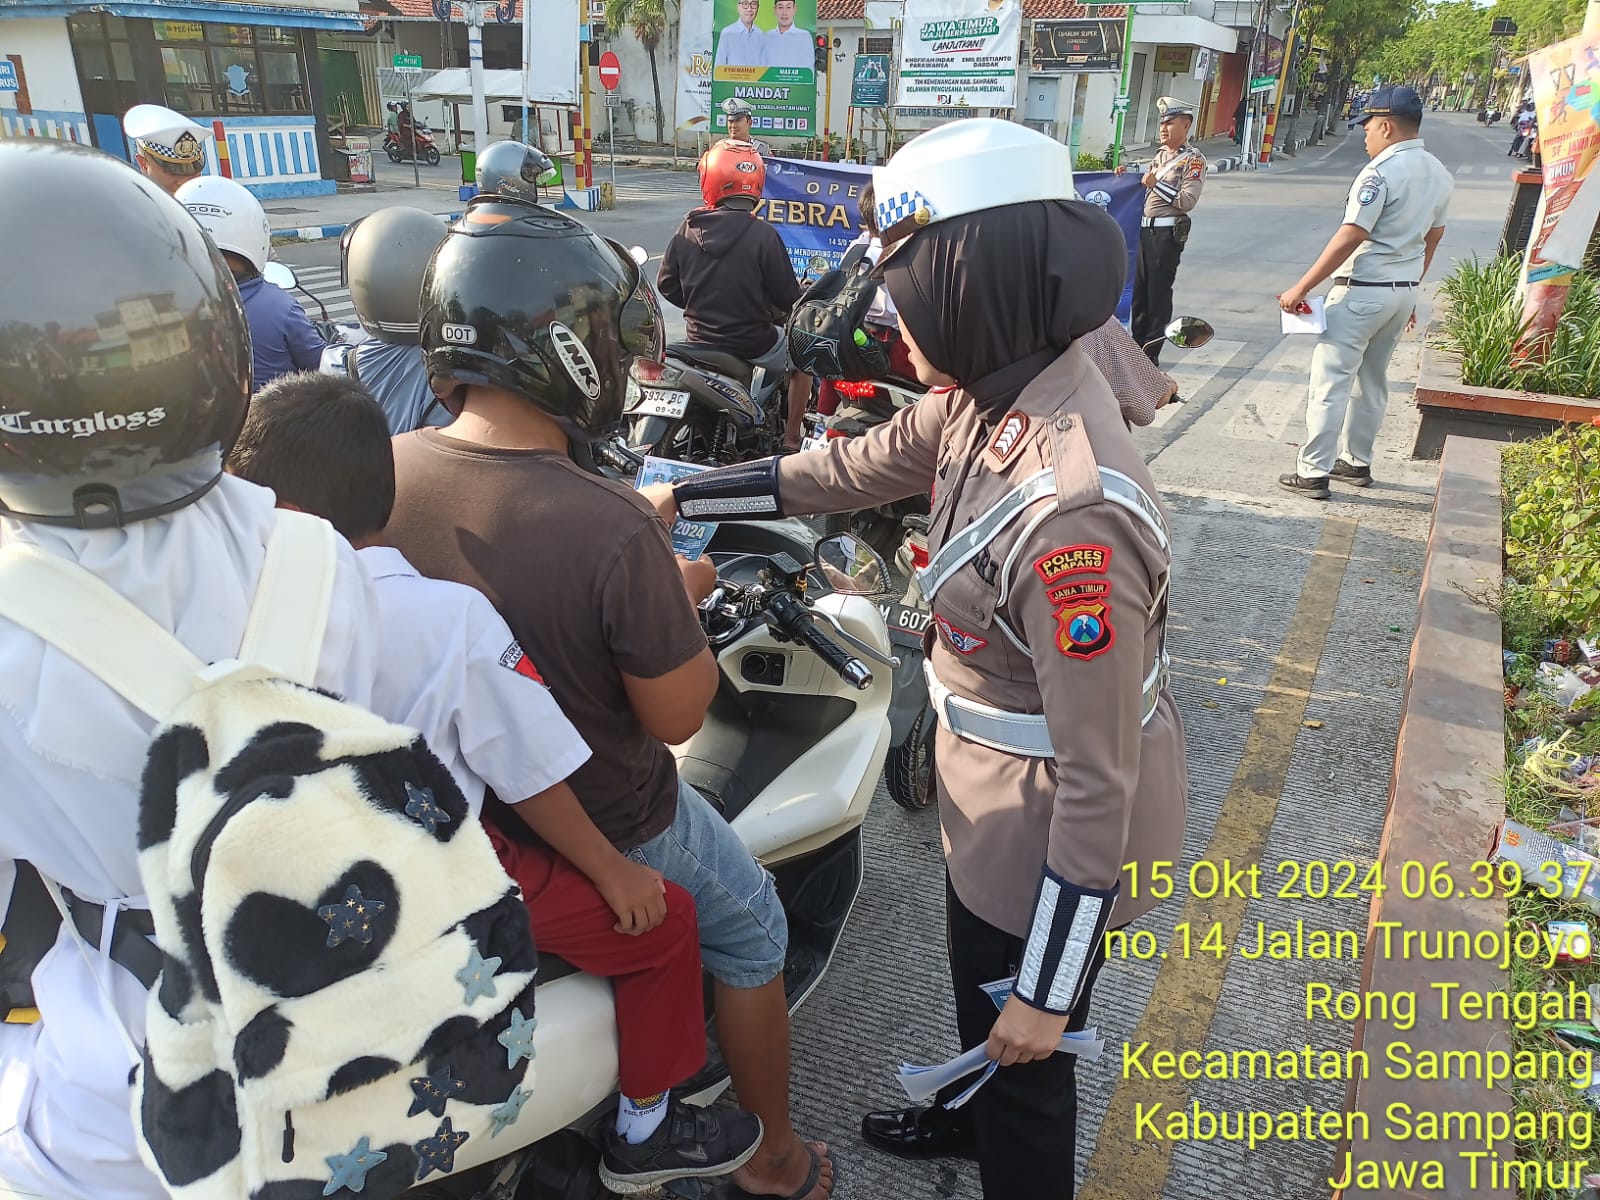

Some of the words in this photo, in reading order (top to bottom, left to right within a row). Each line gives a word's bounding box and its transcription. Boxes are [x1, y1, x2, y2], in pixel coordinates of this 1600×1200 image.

[921, 30, 945, 39] MAJU
[945, 26, 996, 37] BERPRESTASI
[922, 20, 956, 34] JAWA
[957, 17, 993, 29] TIMUR
[734, 86, 790, 100] MANDAT
[446, 326, 472, 341] DOT
[555, 332, 599, 390] INK
[671, 393, 684, 404] BC
[0, 407, 167, 439] Cargloss
[673, 521, 706, 539] 2024
[1042, 550, 1102, 572] POLRES
[1046, 560, 1102, 577] SAMPANG
[1054, 586, 1077, 600] JAWA
[1080, 584, 1105, 593] TIMUR
